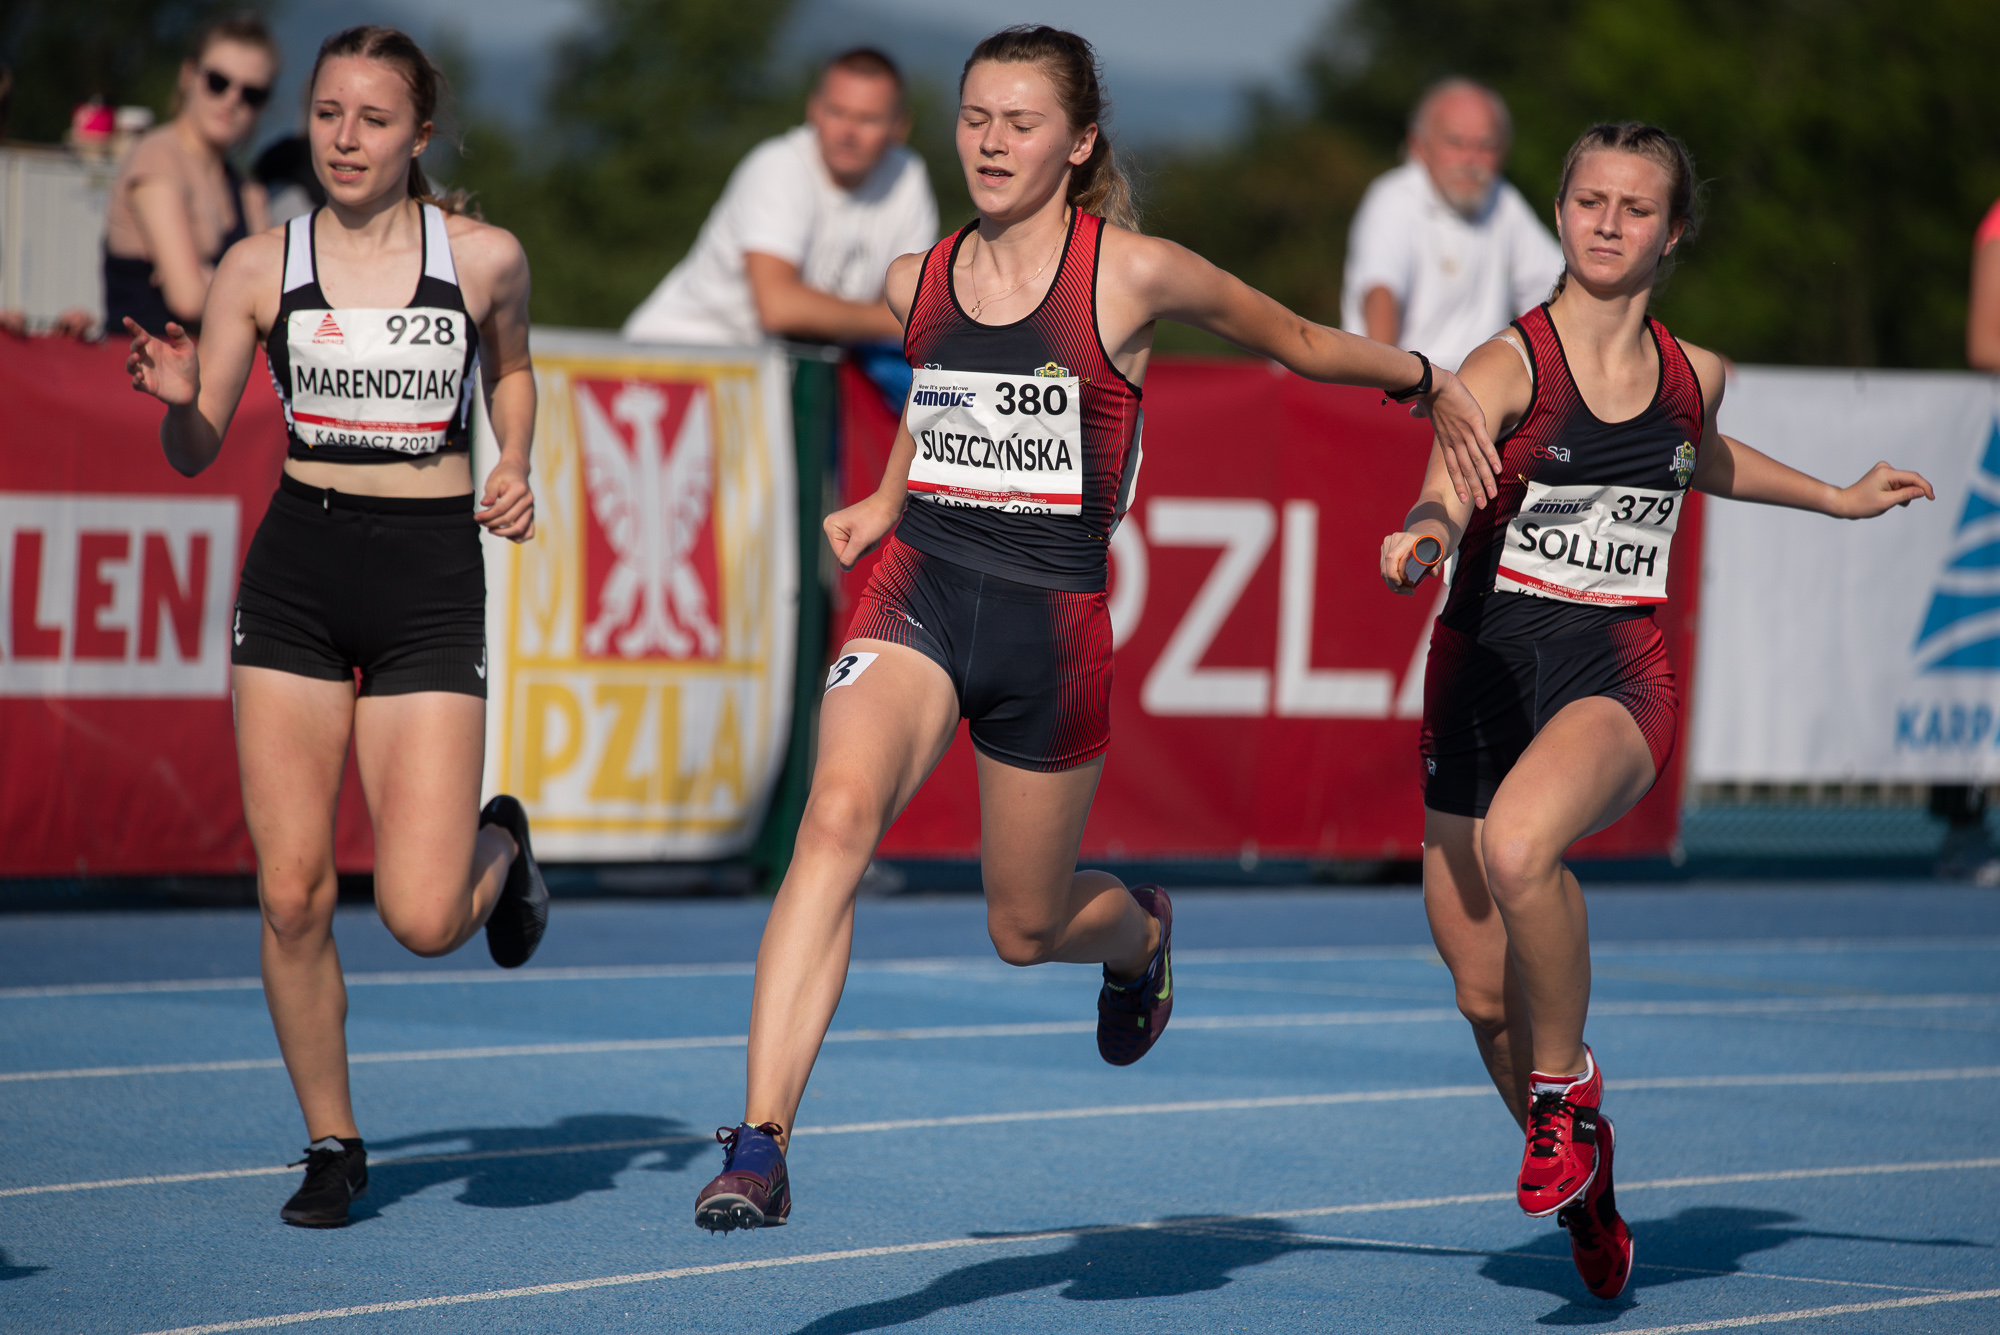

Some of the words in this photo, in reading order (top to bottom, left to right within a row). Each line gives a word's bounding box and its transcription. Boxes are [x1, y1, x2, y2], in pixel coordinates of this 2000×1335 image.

[386, 315, 455, 345] 928
[296, 365, 457, 400] MARENDZIAK
[995, 382, 1068, 416] 380
[315, 429, 394, 450] KARPACZ
[400, 436, 436, 451] 2021
[921, 430, 1073, 471] SUSZCZYŃSKA
[1611, 495, 1675, 526] 379
[1518, 522, 1658, 577] SOLLICH
[0, 527, 212, 664] LEN
[1104, 497, 1450, 719] ZL
[826, 655, 858, 689] 3
[1893, 702, 2000, 753] KARP
